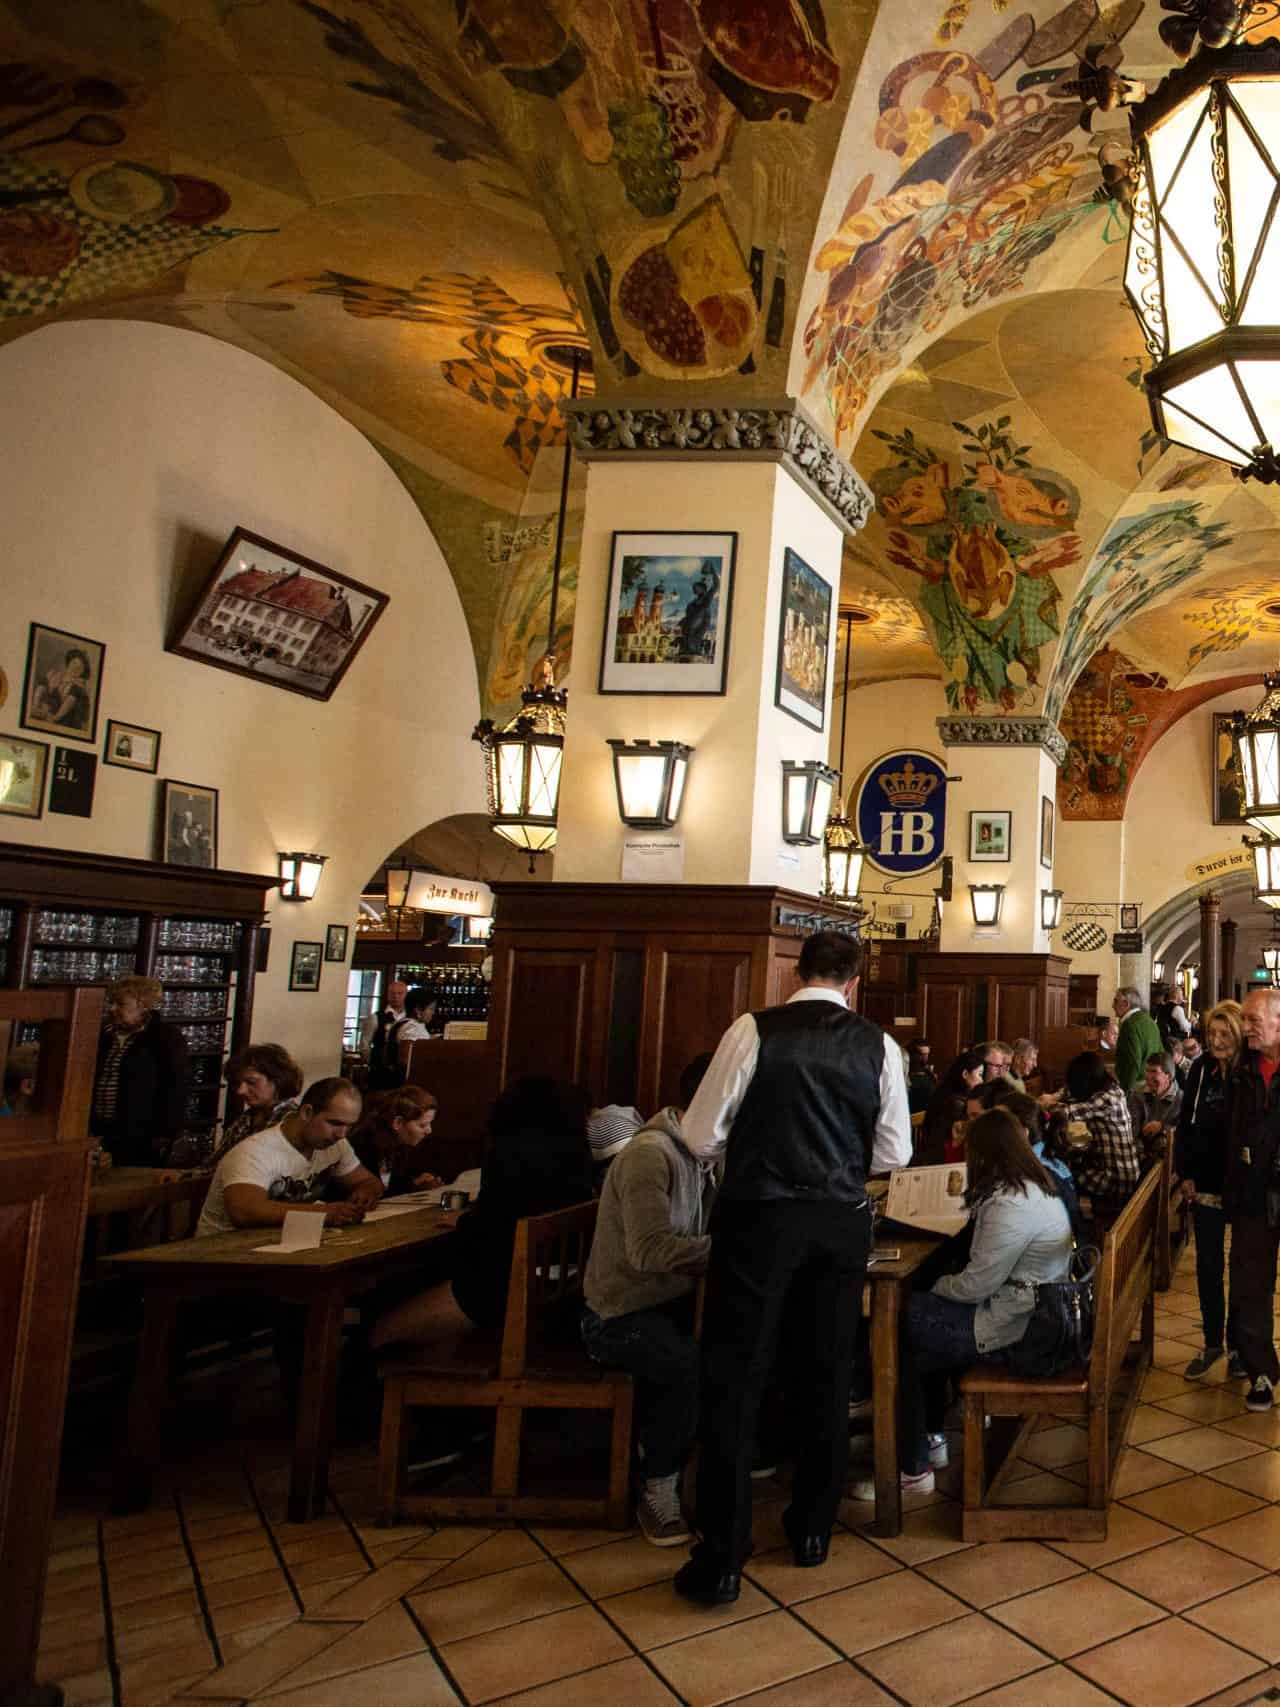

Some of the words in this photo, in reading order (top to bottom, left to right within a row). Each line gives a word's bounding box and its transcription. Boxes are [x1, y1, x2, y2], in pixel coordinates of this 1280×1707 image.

[878, 812, 935, 855] HB
[1195, 857, 1228, 875] Durst
[1229, 854, 1243, 865] ist
